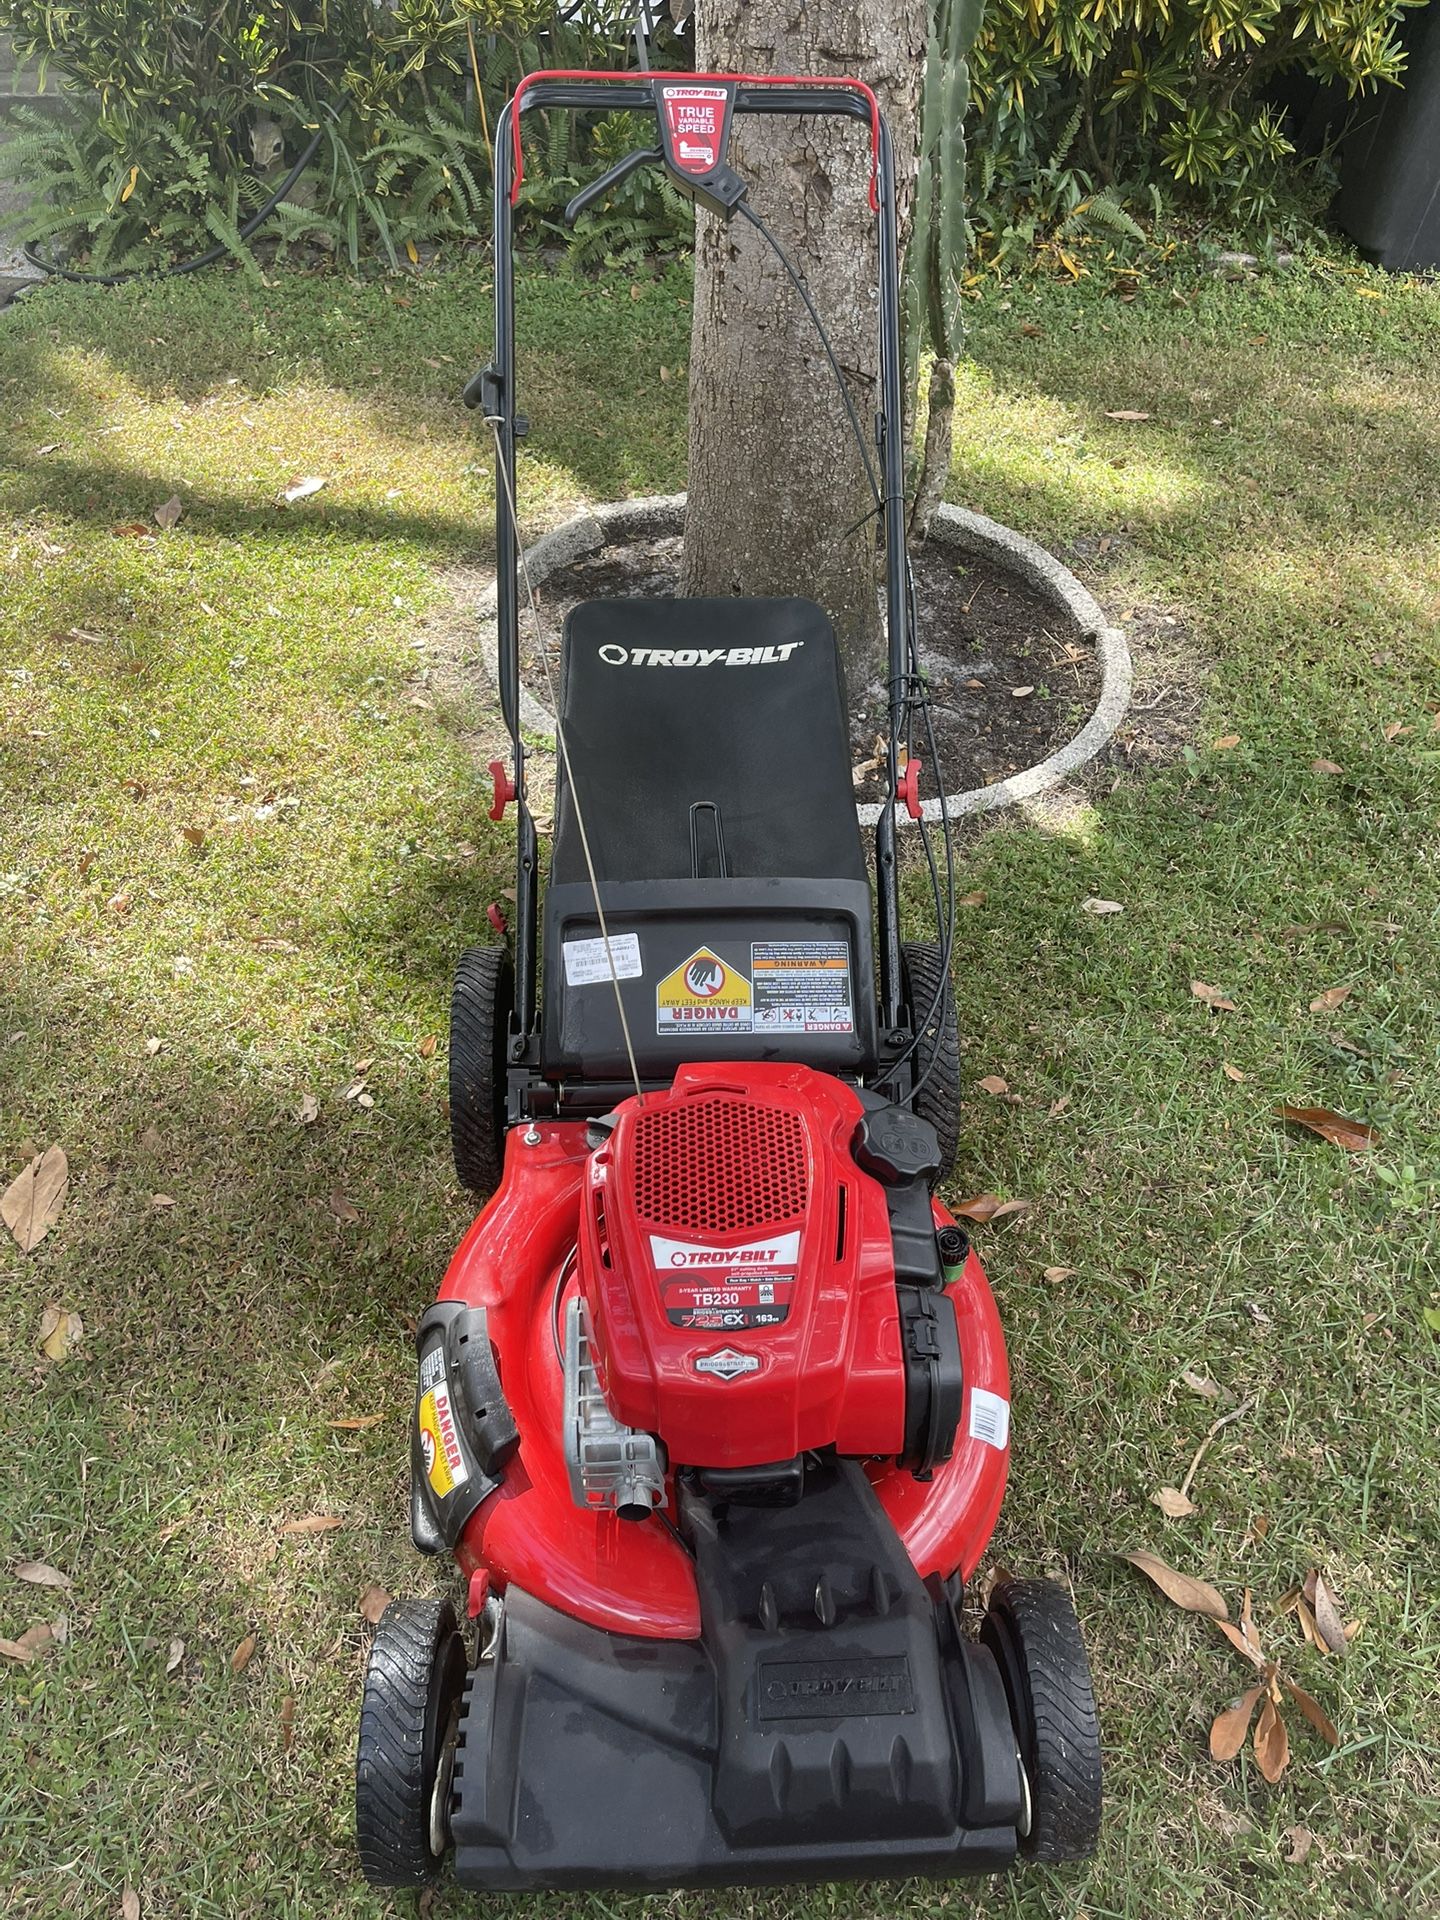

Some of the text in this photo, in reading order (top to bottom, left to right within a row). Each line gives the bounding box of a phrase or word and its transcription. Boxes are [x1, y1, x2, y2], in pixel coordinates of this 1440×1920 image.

[676, 89, 725, 97] TROY-BILT
[678, 106, 715, 118] TRUE
[677, 124, 716, 133] SPEED
[630, 642, 799, 666] TROY-BILT
[672, 1006, 739, 1020] DANGER
[688, 1250, 778, 1264] TROY-BILT
[693, 1292, 739, 1305] TB230
[436, 1395, 462, 1470] DANGER
